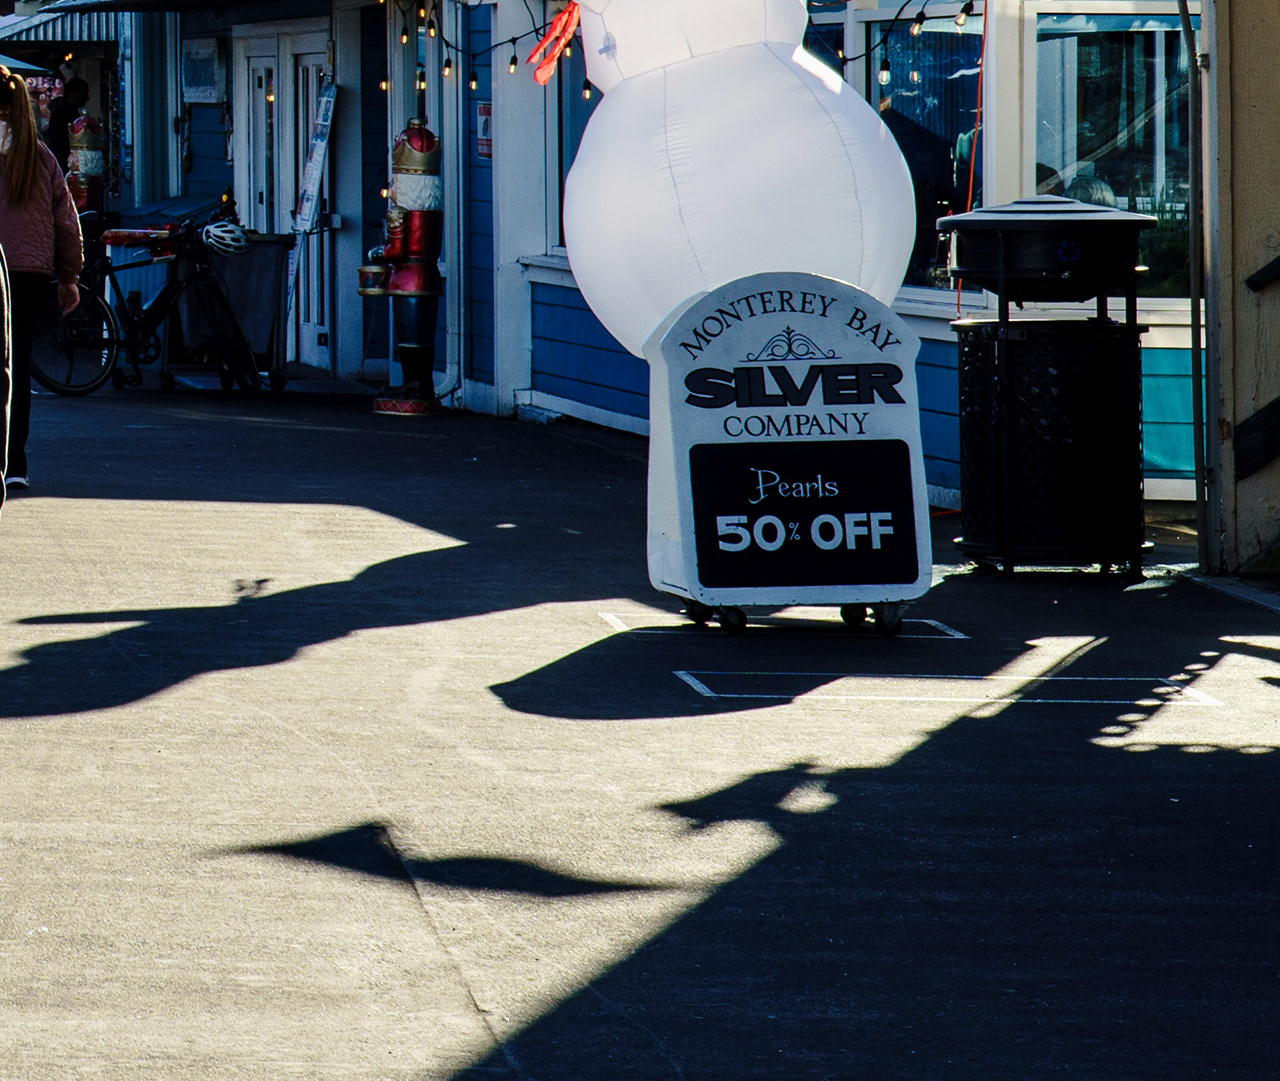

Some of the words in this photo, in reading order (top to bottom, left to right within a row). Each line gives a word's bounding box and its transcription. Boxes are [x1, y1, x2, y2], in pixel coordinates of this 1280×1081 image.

[679, 290, 838, 361] MONTEREY
[845, 307, 902, 352] BAY
[684, 363, 907, 409] SILVER
[723, 412, 870, 437] COMPANY
[748, 467, 839, 505] Pearls
[810, 512, 895, 551] OFF
